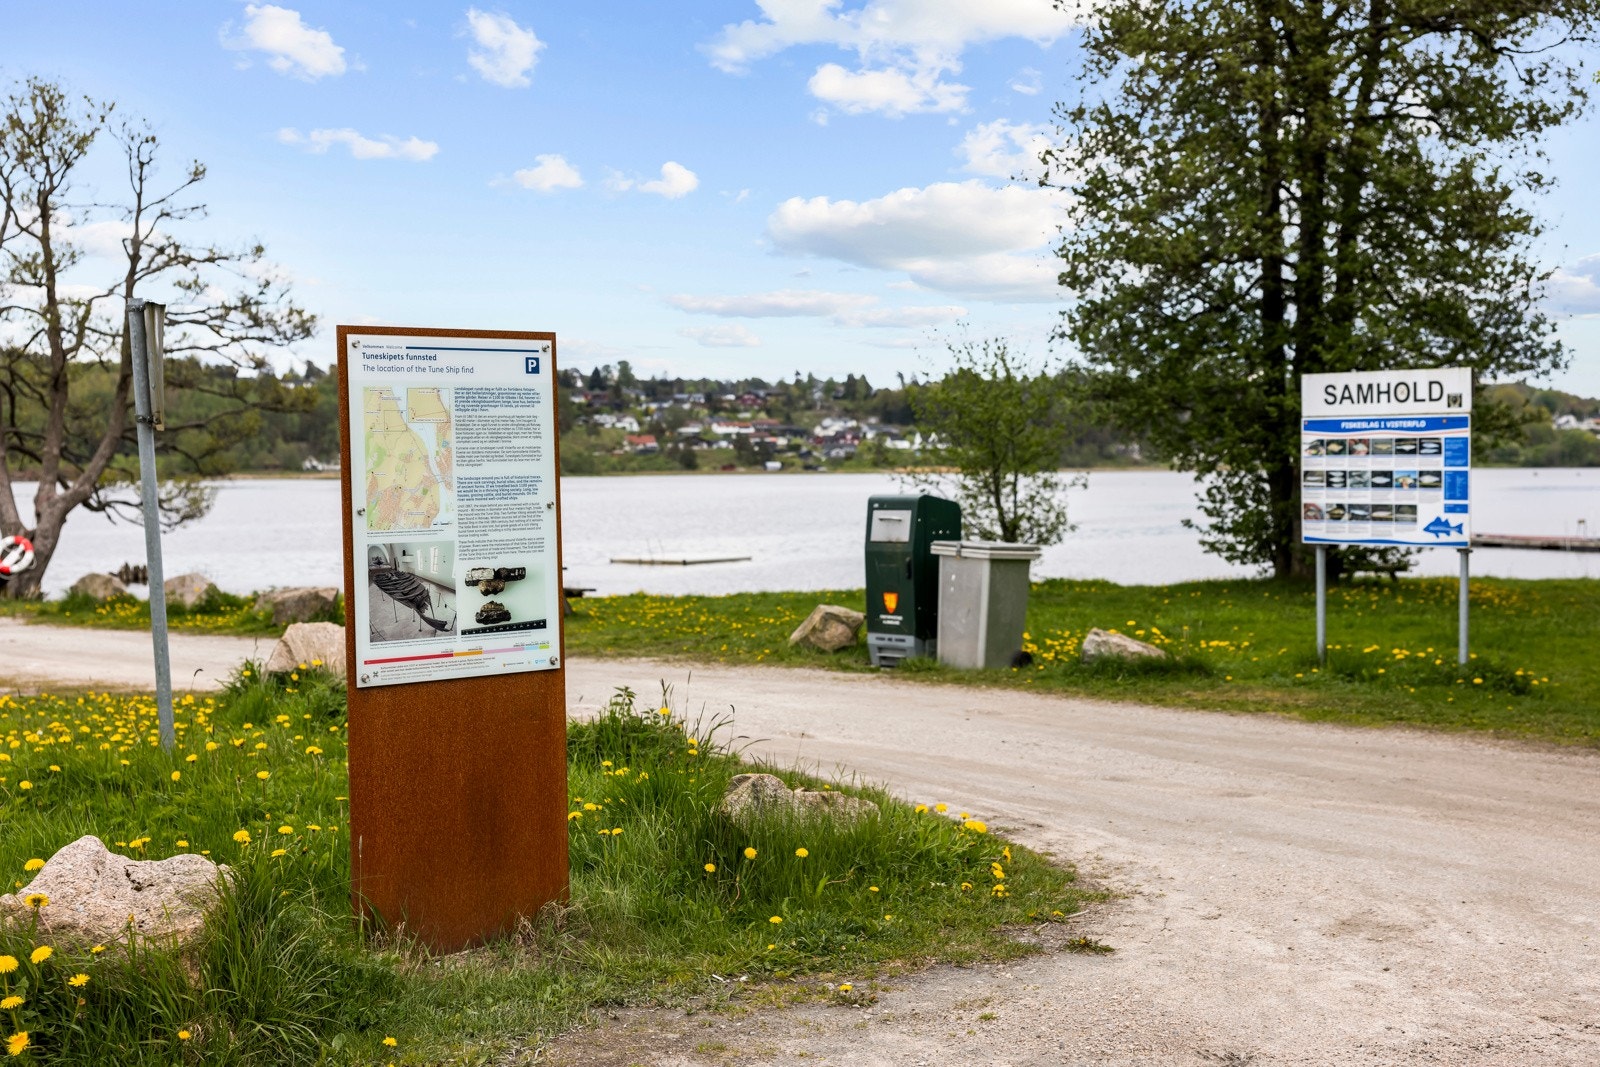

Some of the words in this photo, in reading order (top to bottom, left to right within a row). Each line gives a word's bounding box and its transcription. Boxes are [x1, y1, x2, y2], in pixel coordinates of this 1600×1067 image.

[362, 352, 404, 361] Tuneskipets
[446, 366, 460, 374] Ship
[528, 360, 536, 372] P
[1324, 380, 1444, 405] SAMHOLD
[1341, 421, 1379, 429] FISKESLAG
[1386, 420, 1426, 428] VISTERFLO
